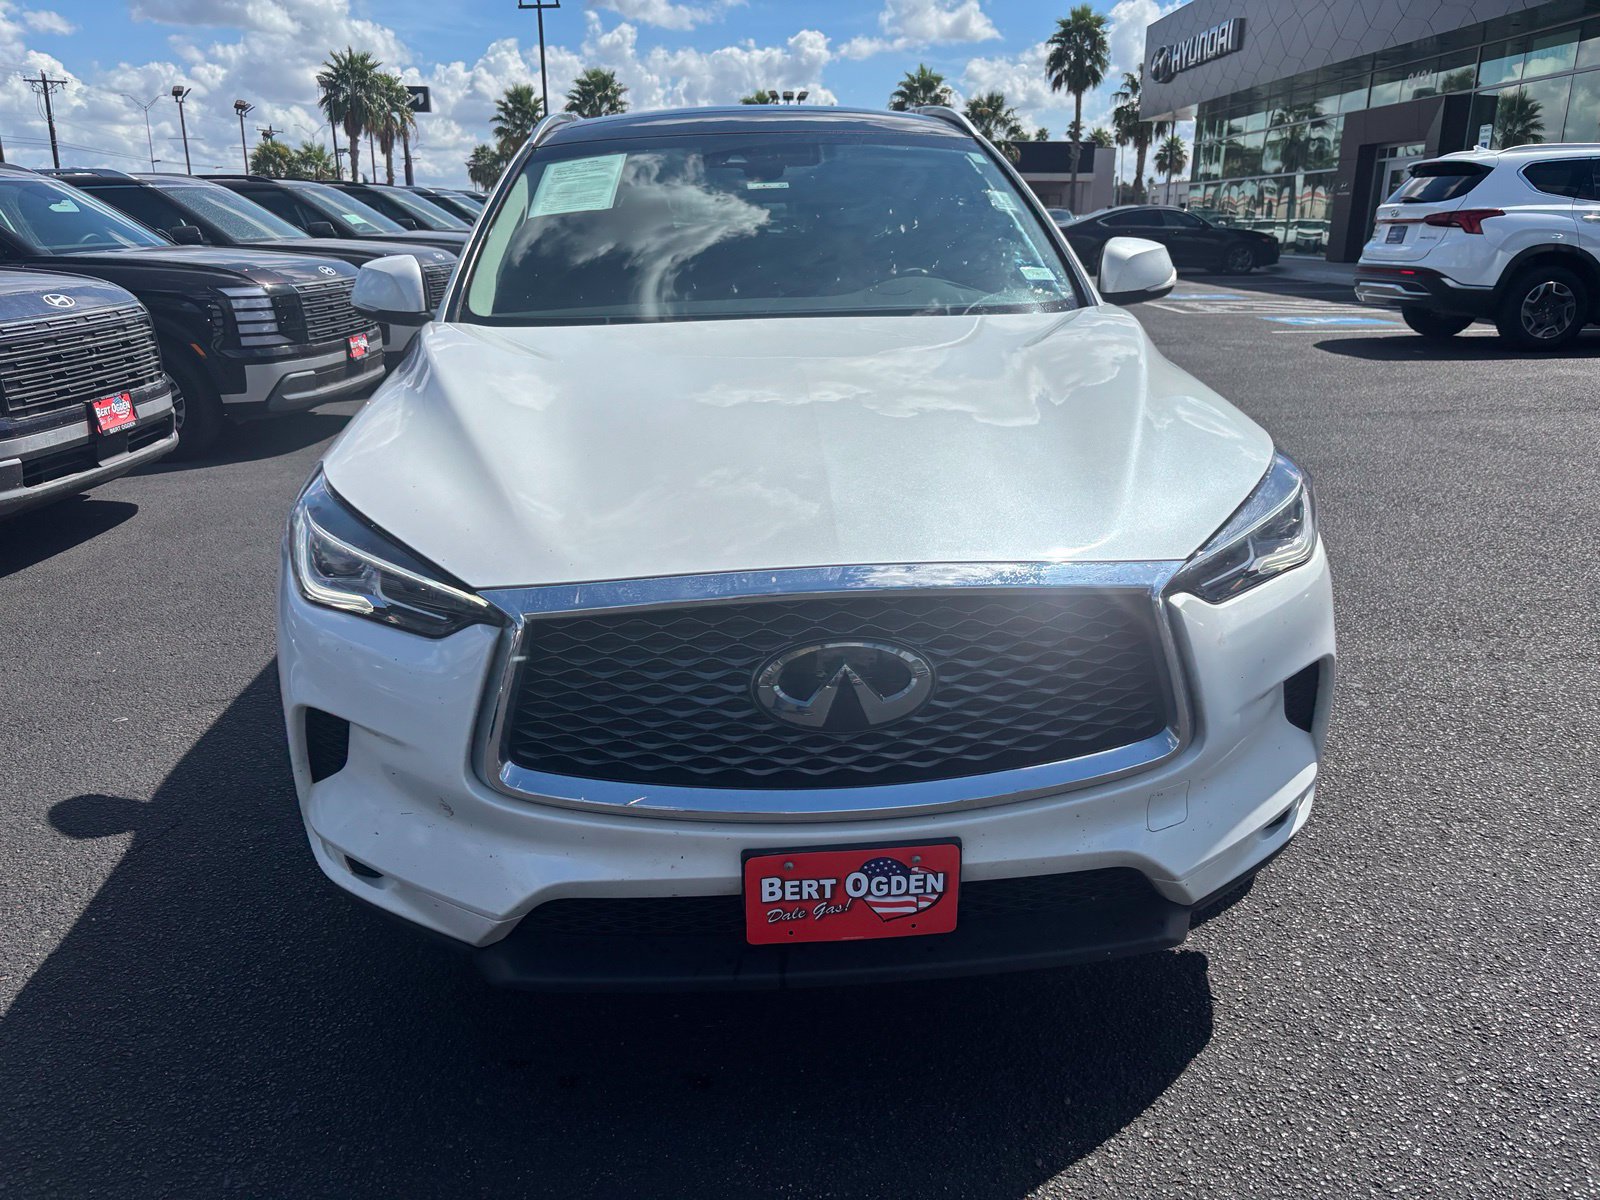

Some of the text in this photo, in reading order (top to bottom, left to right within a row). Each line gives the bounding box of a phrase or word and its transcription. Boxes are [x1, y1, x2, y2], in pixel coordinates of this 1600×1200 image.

[1171, 18, 1236, 73] HYUNDAI
[95, 406, 111, 418] BERT
[761, 872, 945, 903] BERT OGDEN
[766, 898, 853, 924] Dale Gas!
